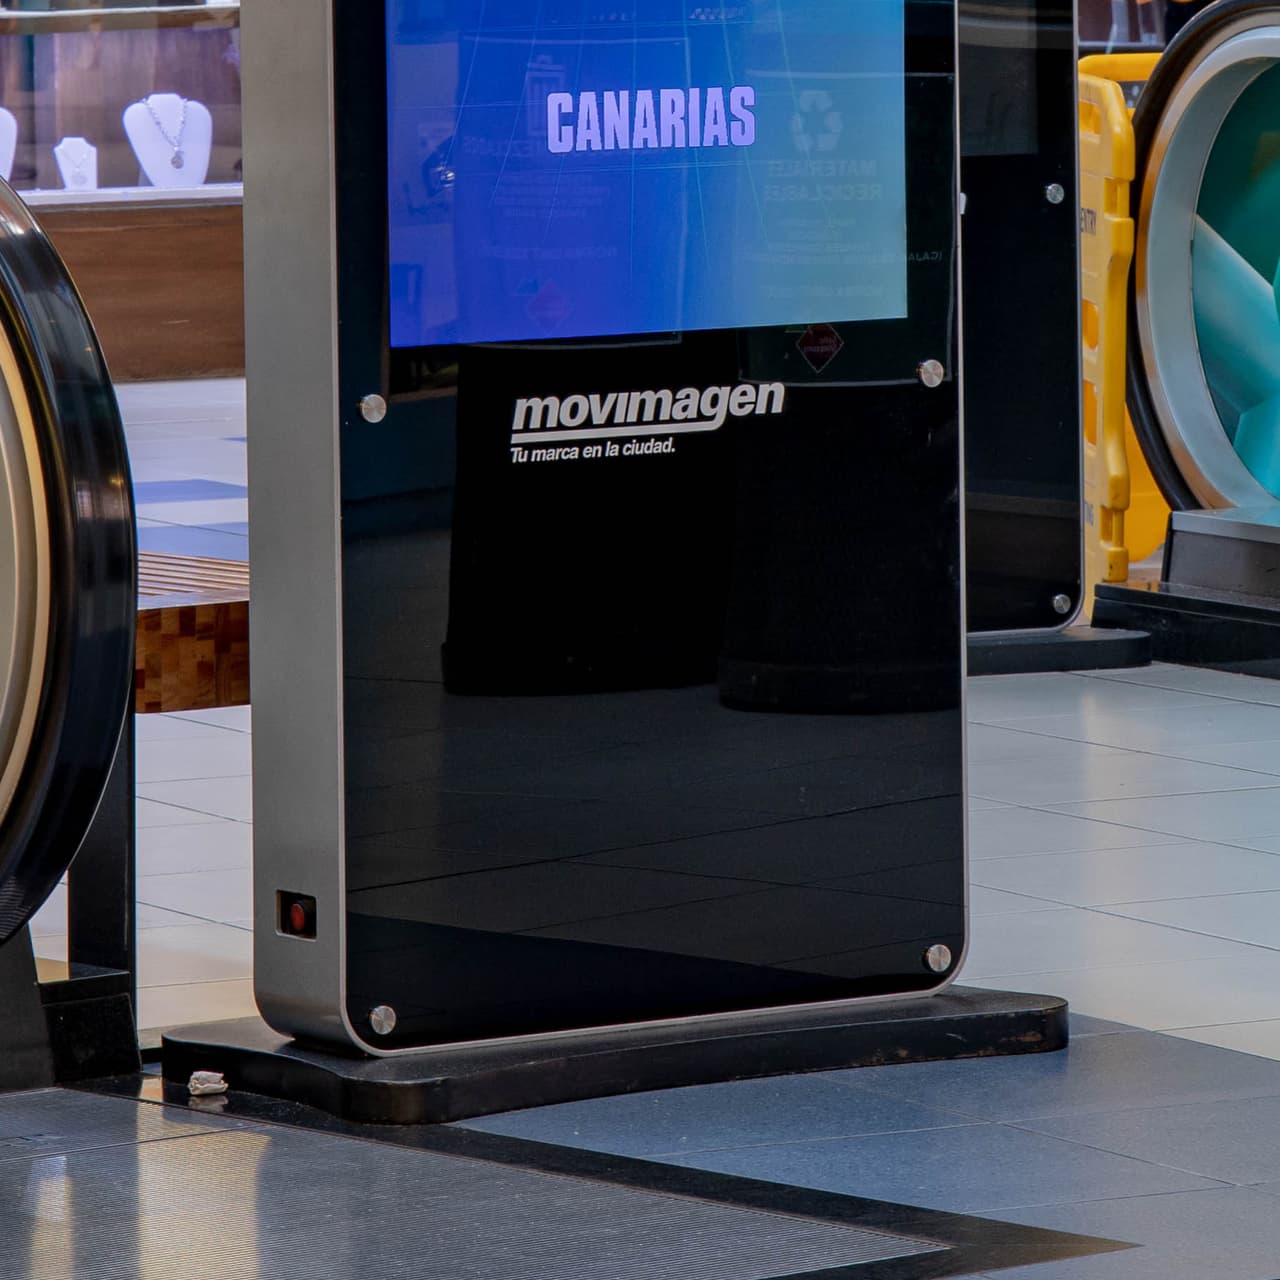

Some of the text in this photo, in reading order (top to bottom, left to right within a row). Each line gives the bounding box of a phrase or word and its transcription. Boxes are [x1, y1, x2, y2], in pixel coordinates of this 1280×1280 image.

[547, 86, 756, 153] CANARIAS
[511, 381, 786, 434] movimagen
[511, 437, 676, 463] Tu marca en la ciudad.
